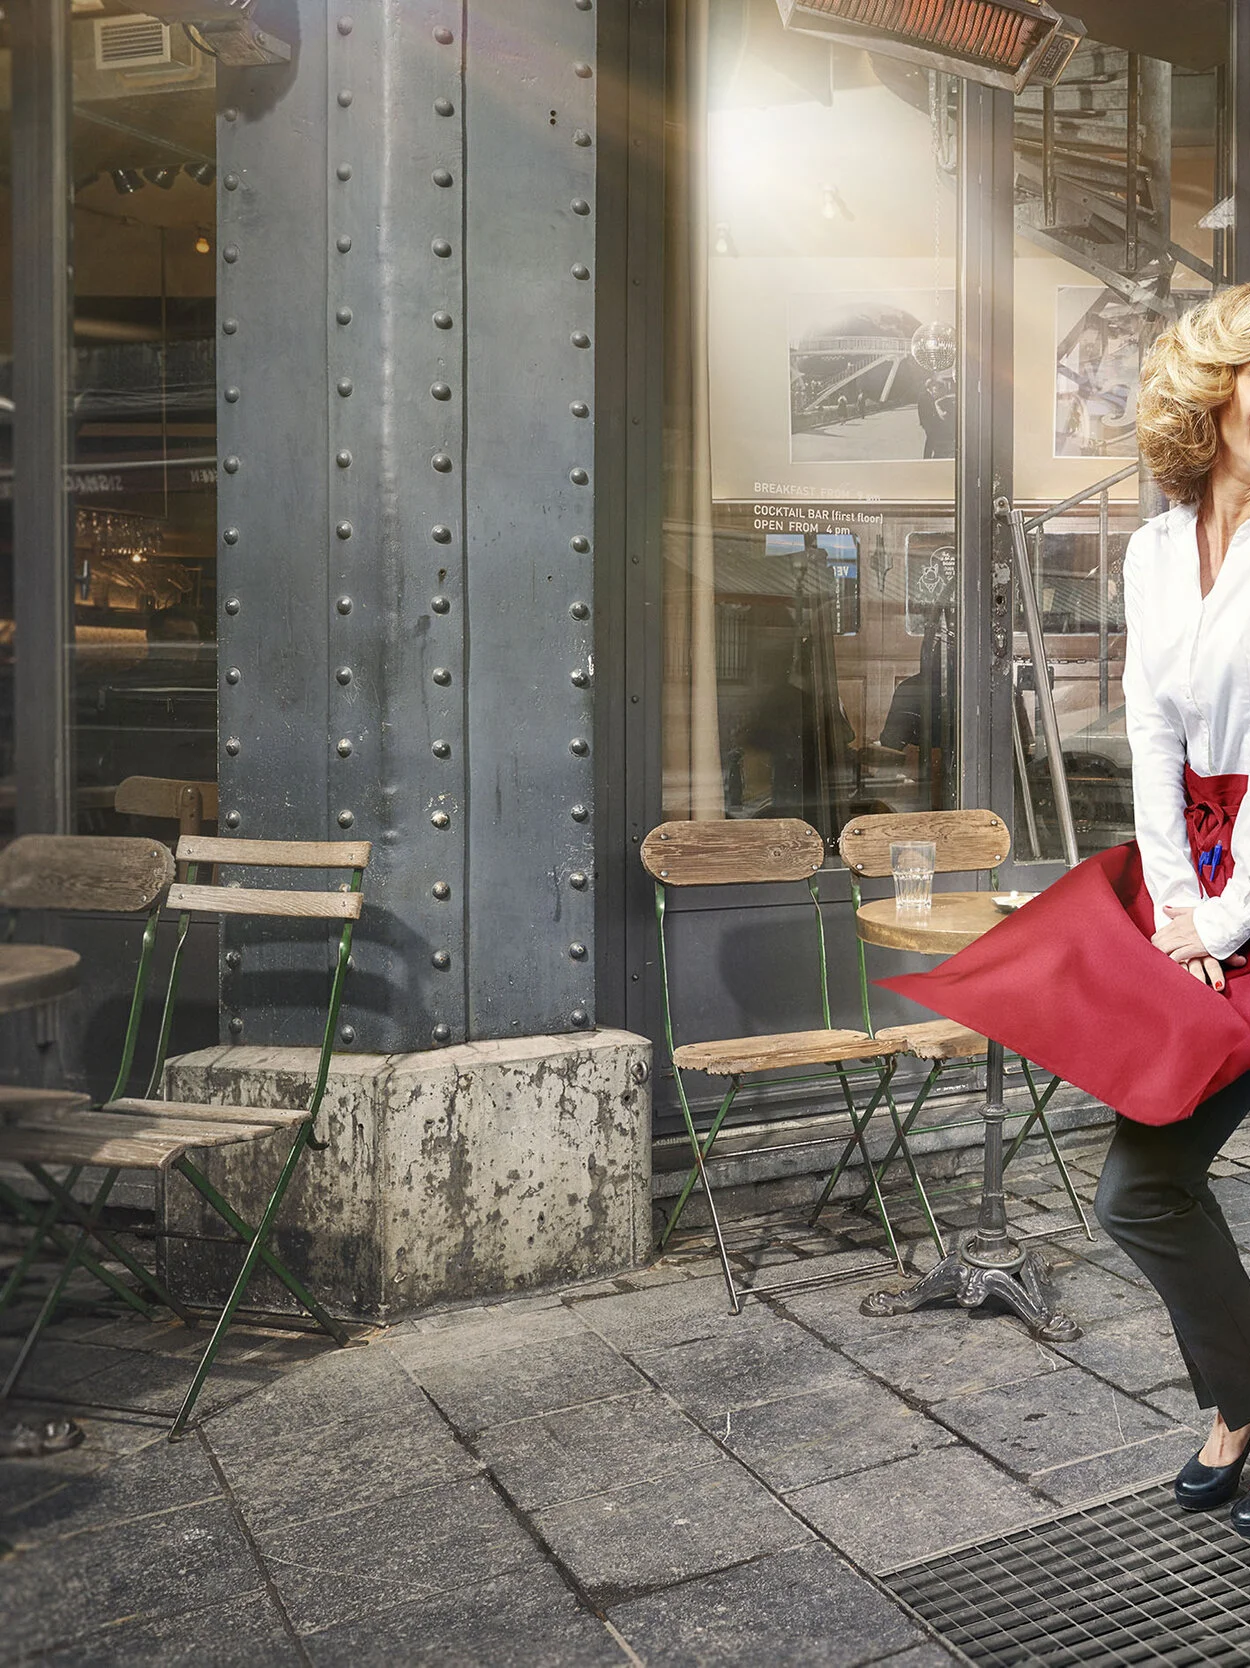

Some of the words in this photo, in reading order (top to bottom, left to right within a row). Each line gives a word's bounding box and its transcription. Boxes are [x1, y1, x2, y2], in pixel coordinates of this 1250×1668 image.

[754, 481, 816, 498] BREAKFAST
[820, 487, 851, 500] FROM
[754, 504, 805, 519] COCKTAIL
[808, 508, 829, 520] BAR
[831, 509, 855, 522] (first
[857, 512, 883, 525] floor)
[754, 518, 783, 531] OPEN
[788, 520, 819, 533] FROM
[826, 524, 832, 534] 4
[834, 526, 850, 536] pm
